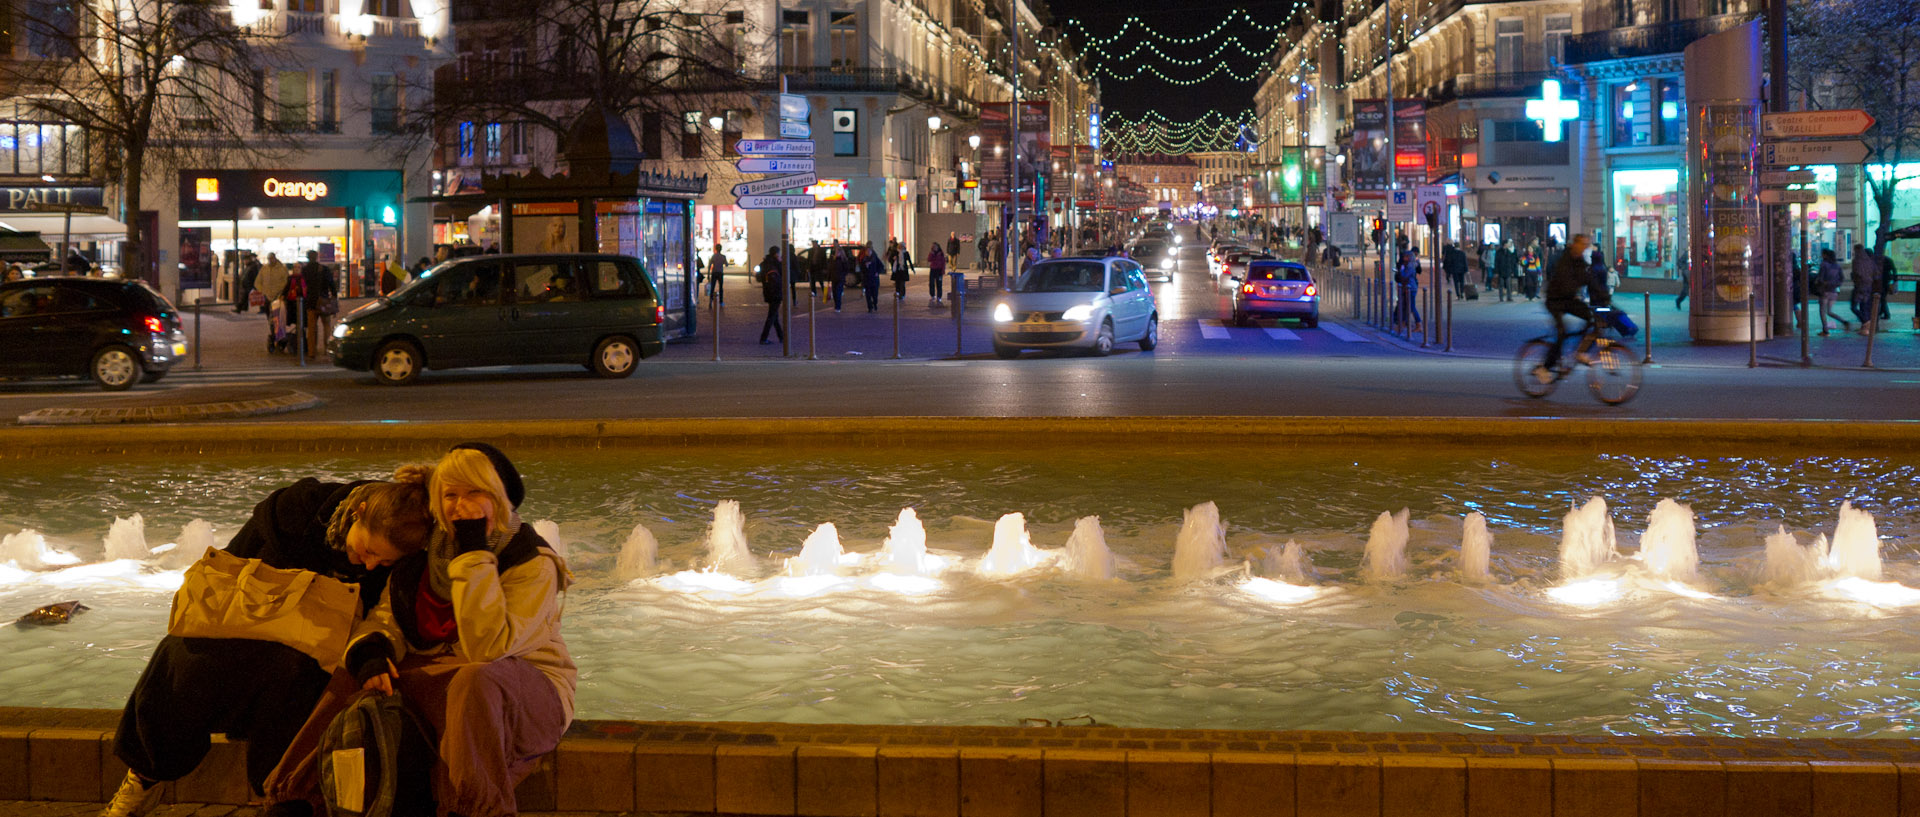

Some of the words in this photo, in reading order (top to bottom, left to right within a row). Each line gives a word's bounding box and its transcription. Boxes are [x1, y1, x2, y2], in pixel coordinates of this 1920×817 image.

[1777, 116, 1803, 124] Centre
[1808, 113, 1858, 123] Commercial
[1778, 124, 1823, 133] URALILLE
[771, 142, 784, 151] Lille
[786, 143, 812, 152] Flandres
[1777, 145, 1796, 153] Lille
[1802, 145, 1832, 154] Europe
[780, 161, 812, 170] Tanneurs
[264, 178, 328, 201] Orange
[517, 203, 529, 214] TV
